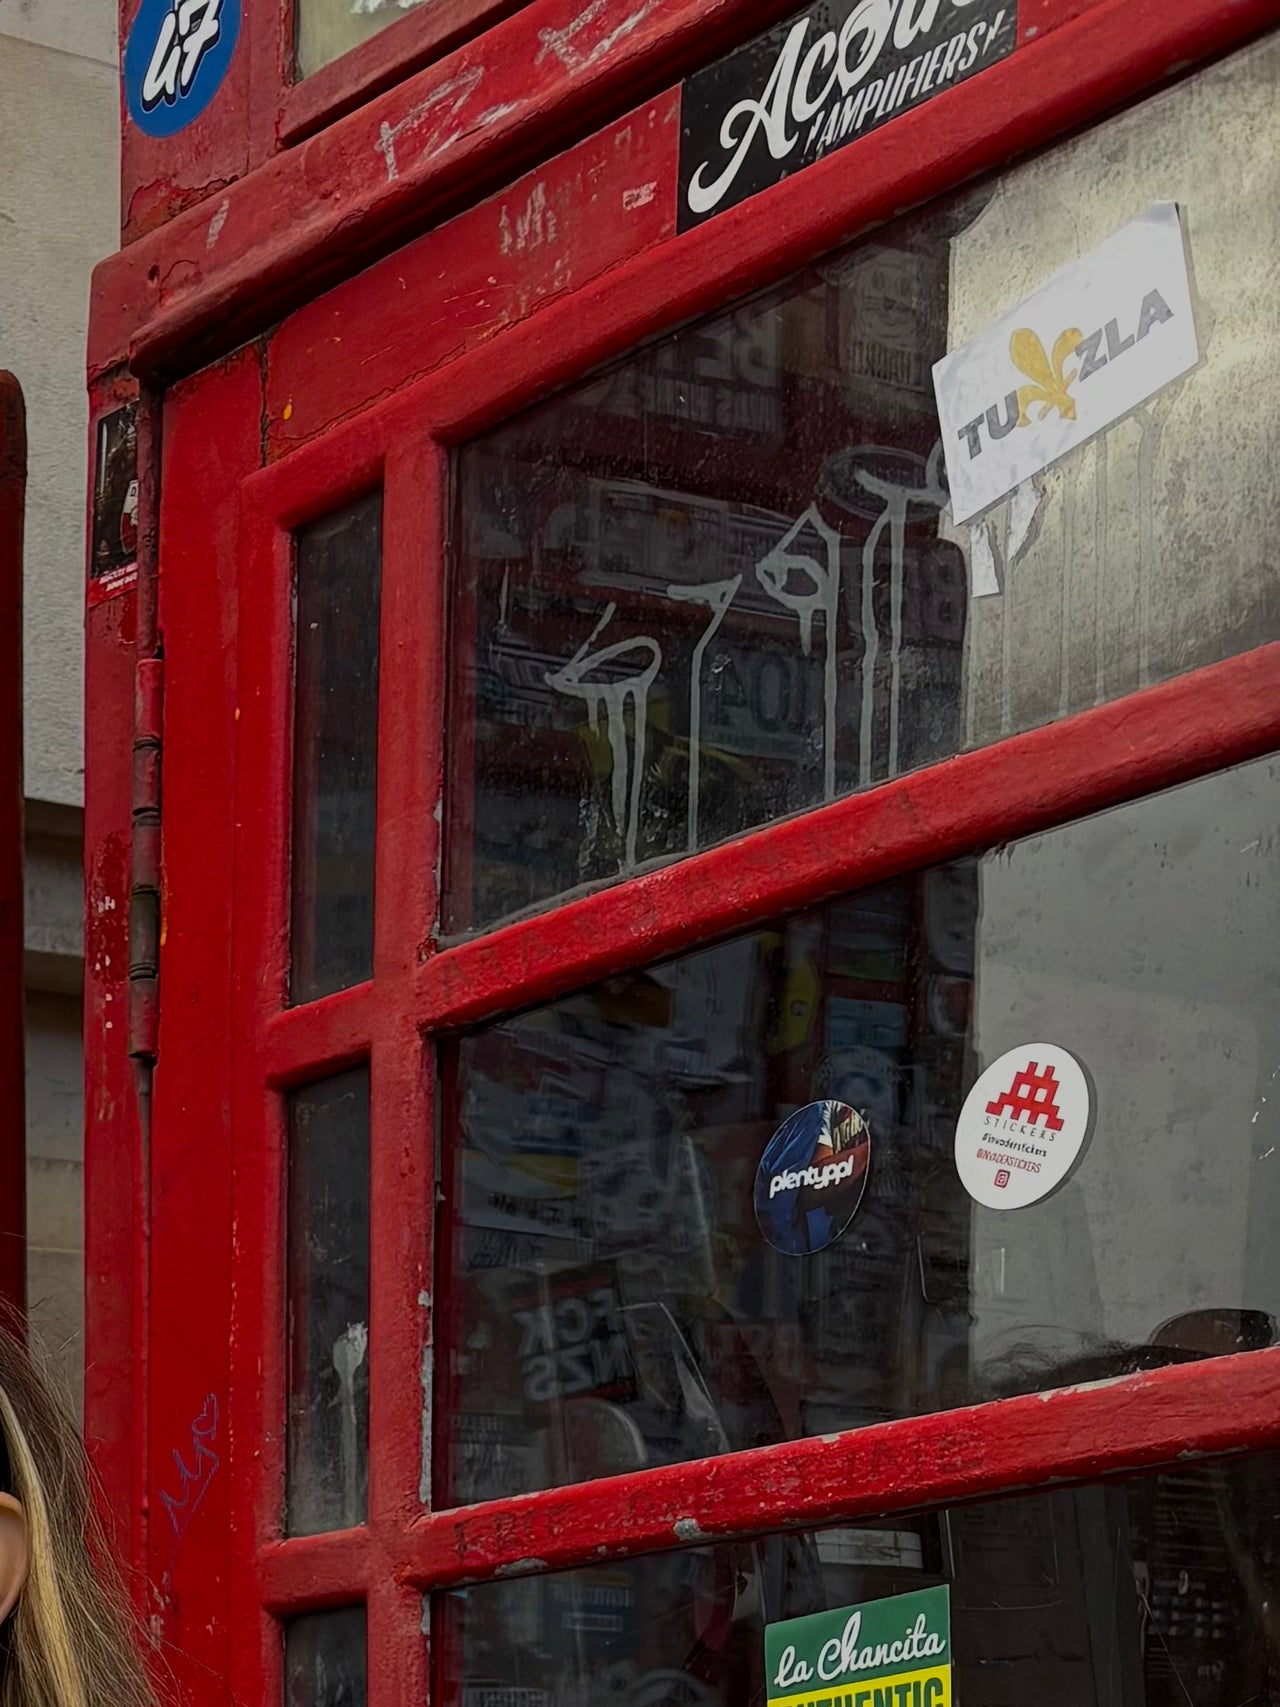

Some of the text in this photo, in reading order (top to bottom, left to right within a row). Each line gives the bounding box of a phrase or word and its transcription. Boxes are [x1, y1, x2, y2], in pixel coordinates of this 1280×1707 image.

[816, 36, 981, 152] AMPLIFIERS
[983, 1115, 1057, 1143] STICKERS
[768, 1155, 854, 1199] plentyppl
[817, 1610, 946, 1683] Chancita
